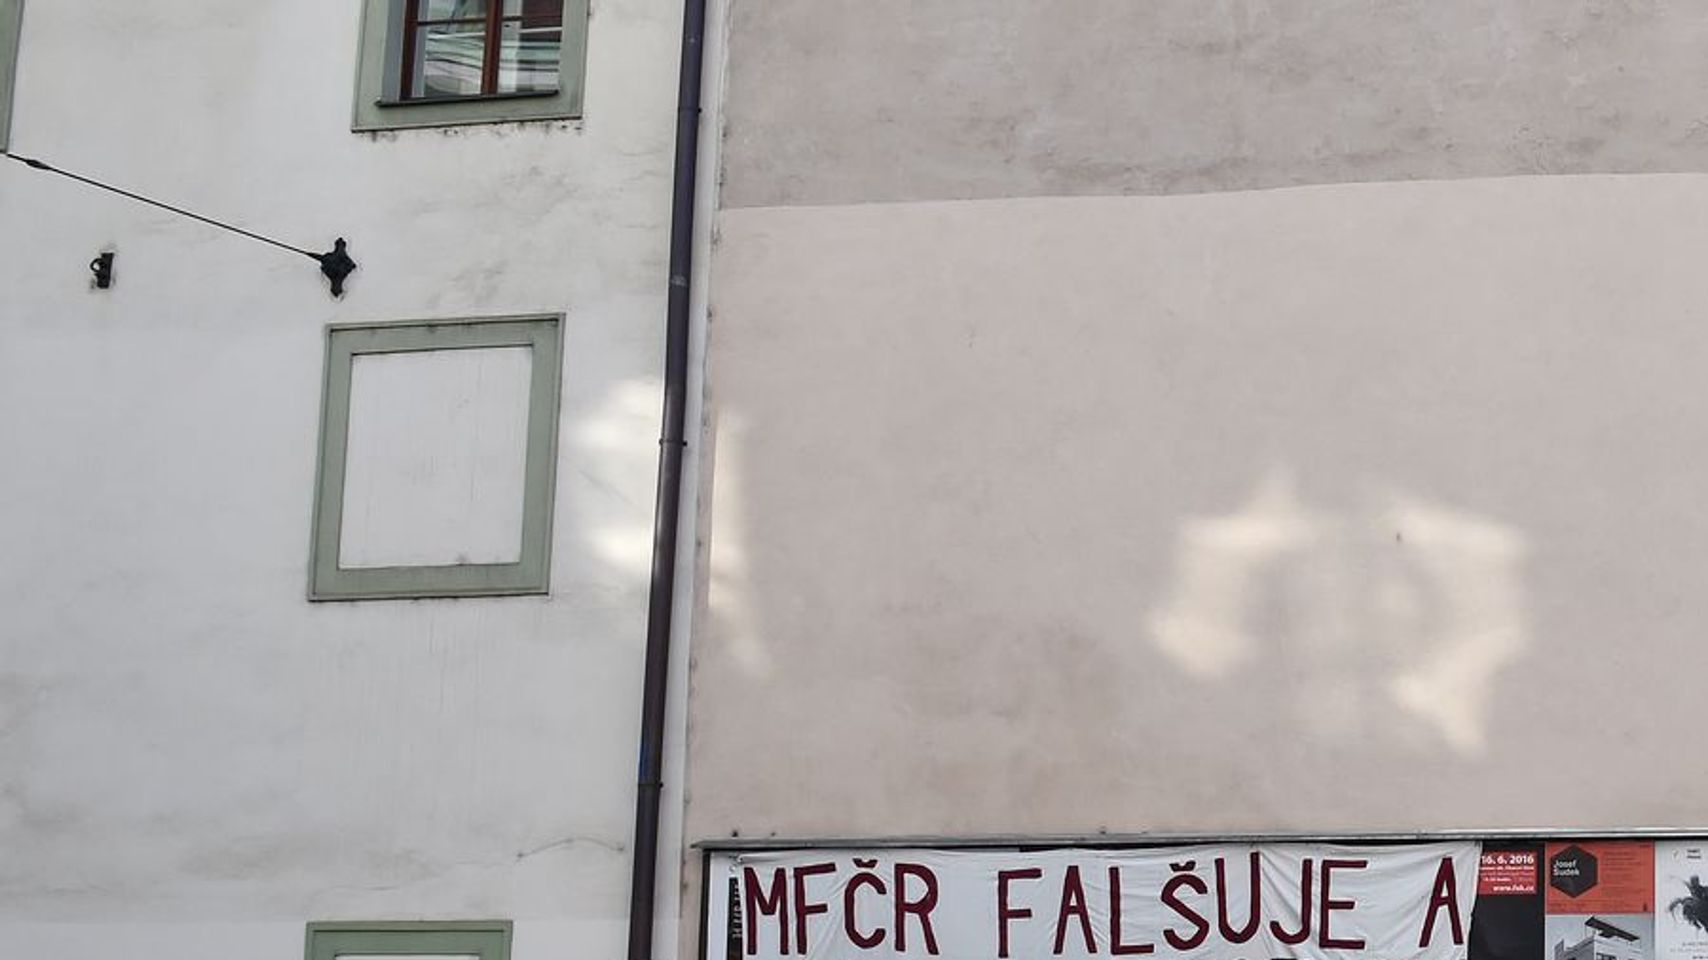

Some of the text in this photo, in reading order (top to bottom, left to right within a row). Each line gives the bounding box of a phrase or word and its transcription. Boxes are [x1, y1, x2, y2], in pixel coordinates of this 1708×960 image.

[1510, 855, 1535, 864] 2016
[1553, 859, 1577, 869] Josef
[744, 859, 939, 956] MFČR
[999, 851, 1366, 959] FALŠUJE
[1419, 856, 1464, 948] A
